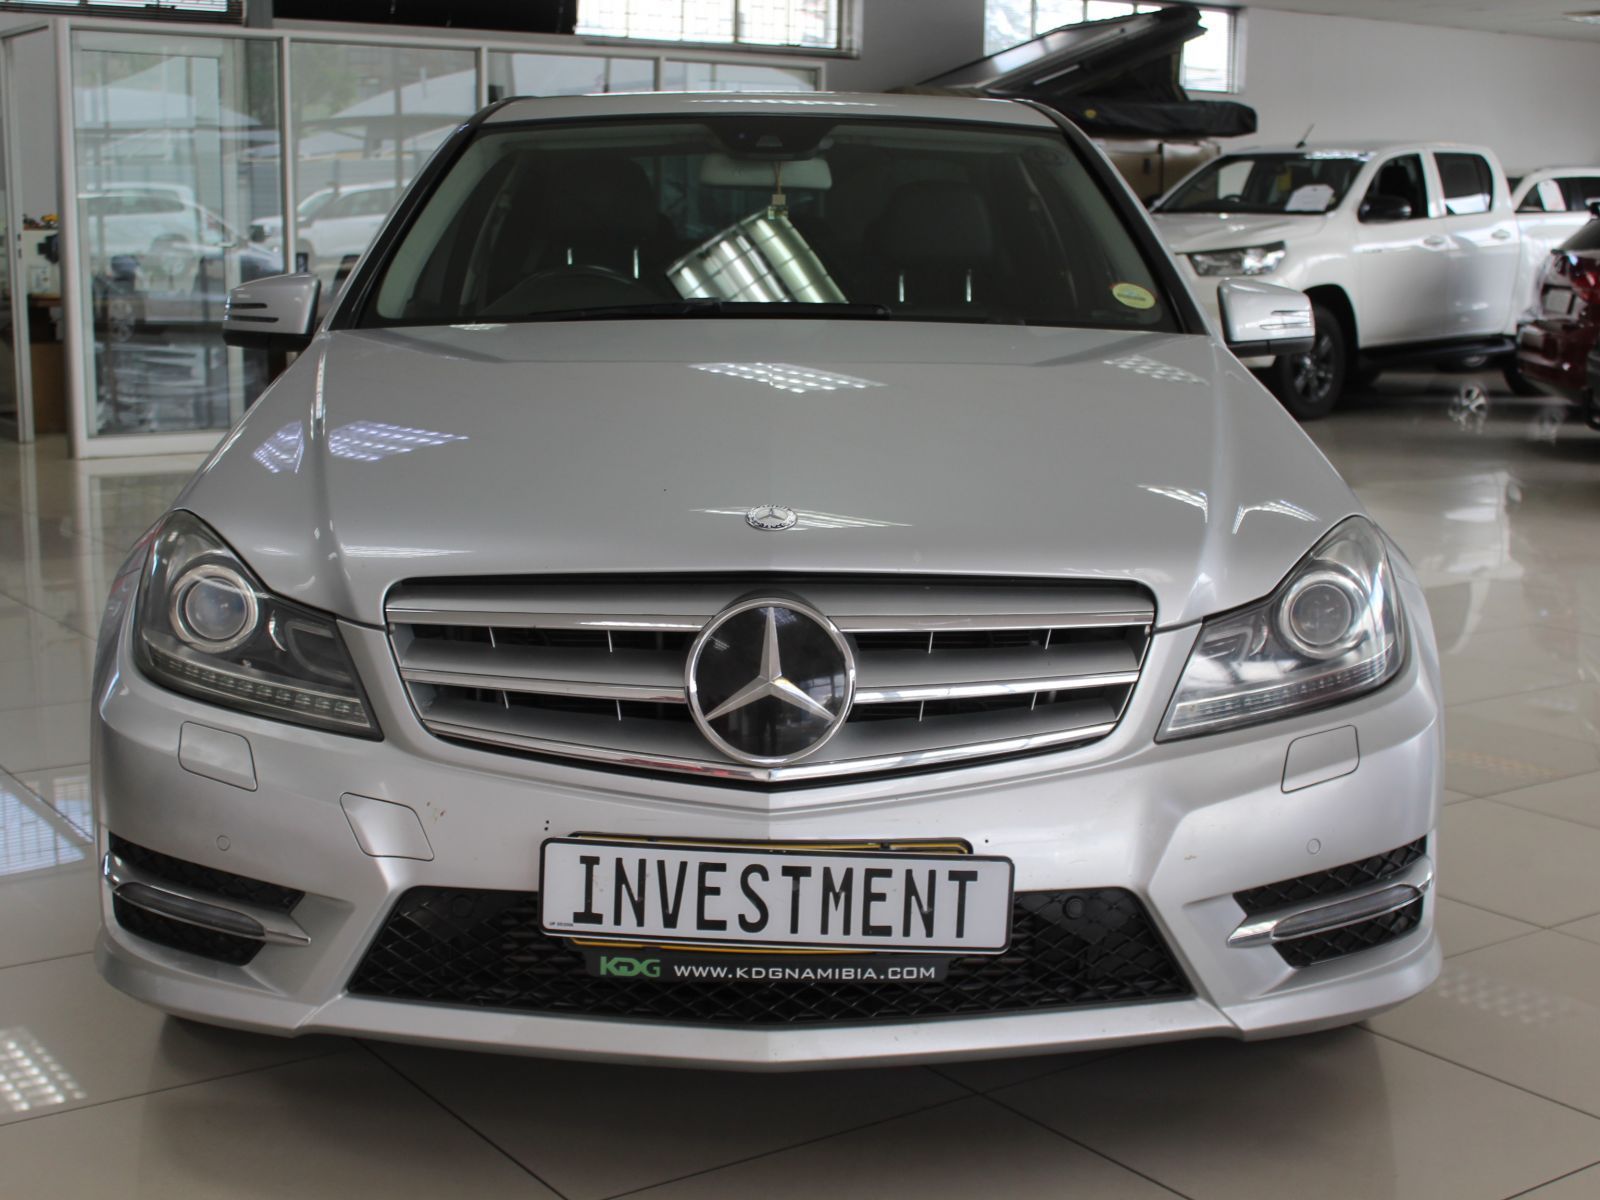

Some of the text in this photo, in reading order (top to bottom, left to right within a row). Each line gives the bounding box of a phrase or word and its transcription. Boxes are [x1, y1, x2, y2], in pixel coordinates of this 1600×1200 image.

[573, 855, 978, 939] INVESTMENT
[600, 956, 936, 980] KDG WWW.KDGNAMIBIA.COM
